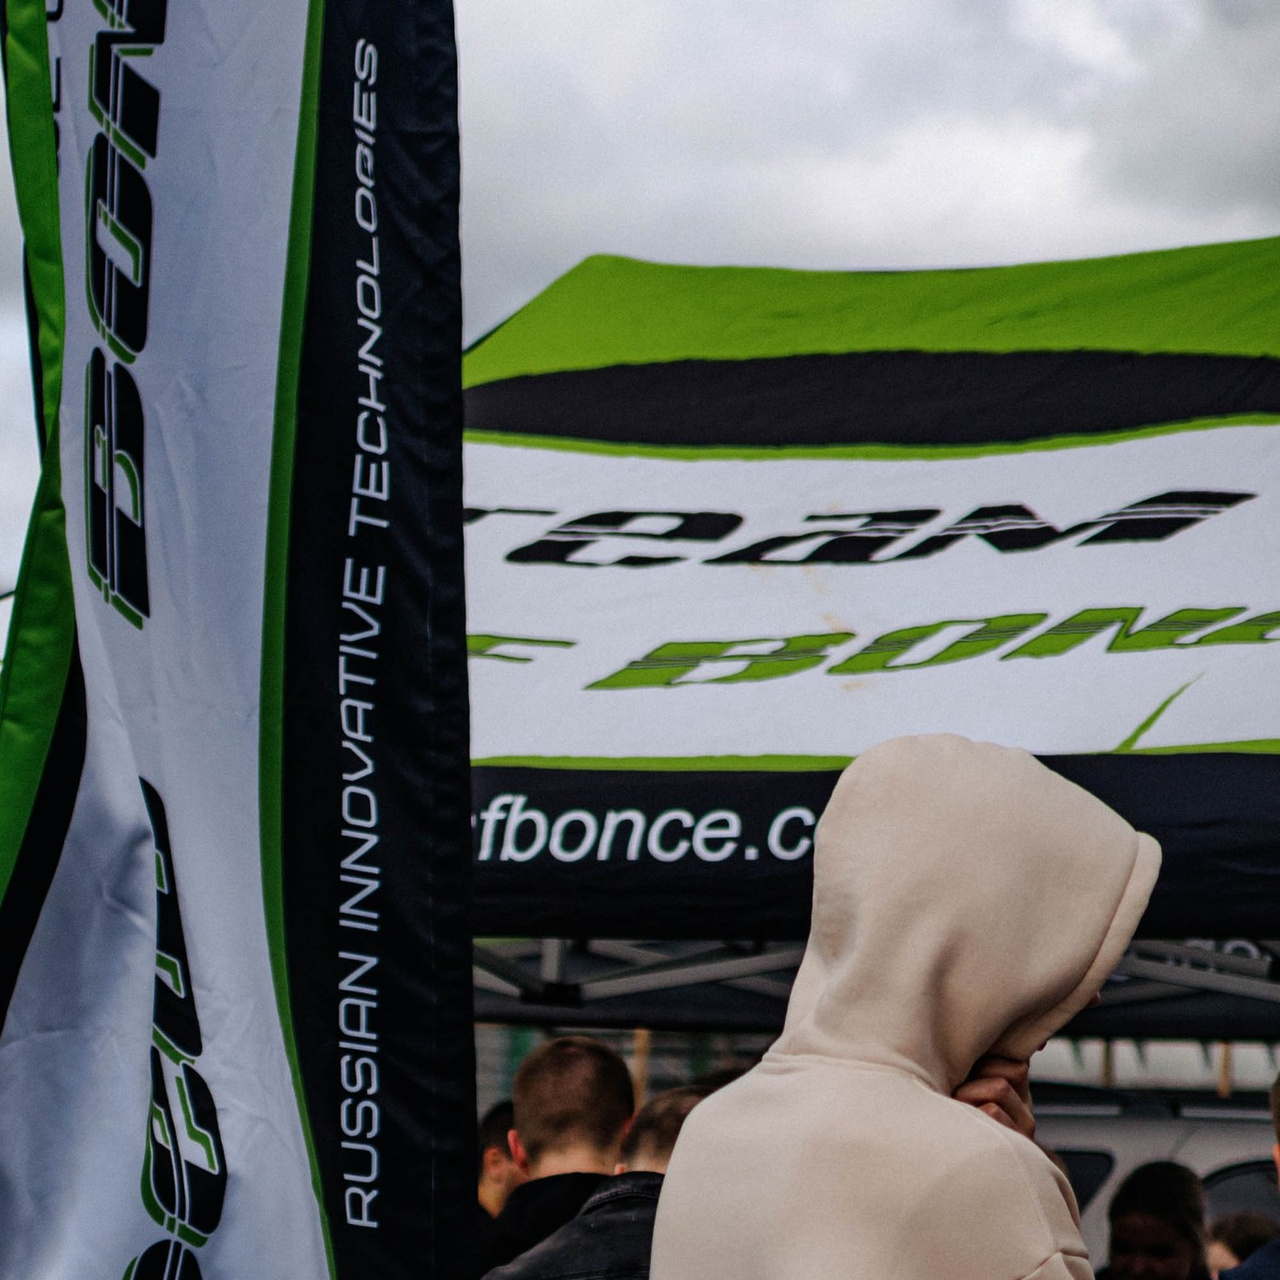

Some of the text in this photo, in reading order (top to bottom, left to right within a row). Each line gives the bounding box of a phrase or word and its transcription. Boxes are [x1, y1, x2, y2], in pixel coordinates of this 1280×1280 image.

[338, 38, 390, 1229] RUSSIAN INNOVATIVE TECHNOLOGIES
[471, 793, 816, 862] fbonce.c
